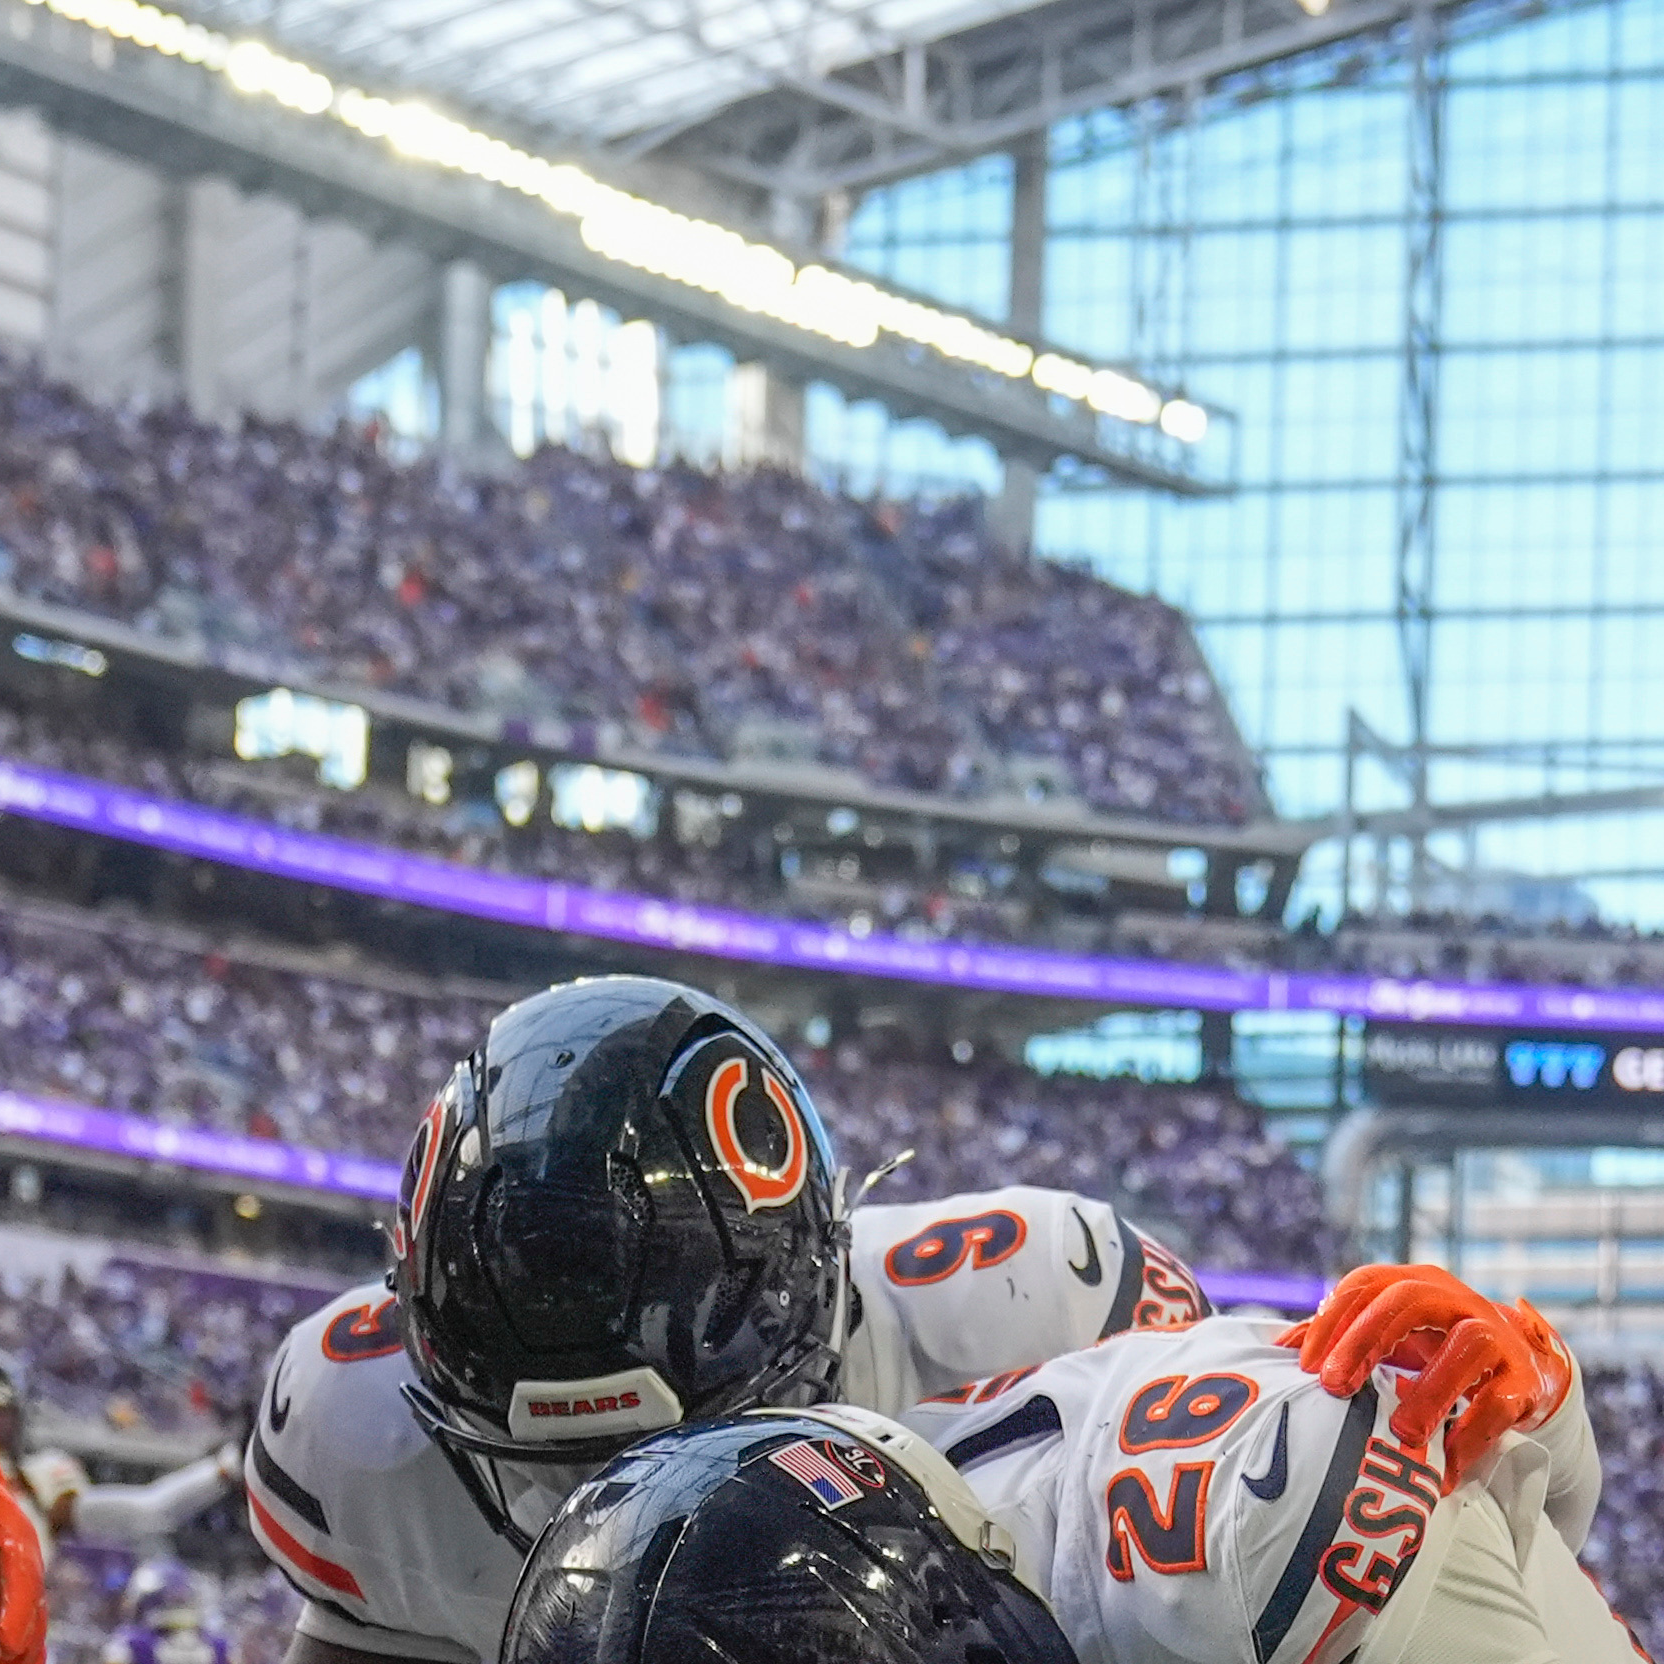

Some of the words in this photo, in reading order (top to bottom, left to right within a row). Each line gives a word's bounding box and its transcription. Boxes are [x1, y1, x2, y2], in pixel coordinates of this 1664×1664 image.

[527, 1391, 641, 1417] BEARS
[1106, 1372, 1260, 1582] 26
[1318, 1437, 1442, 1616] GSH
